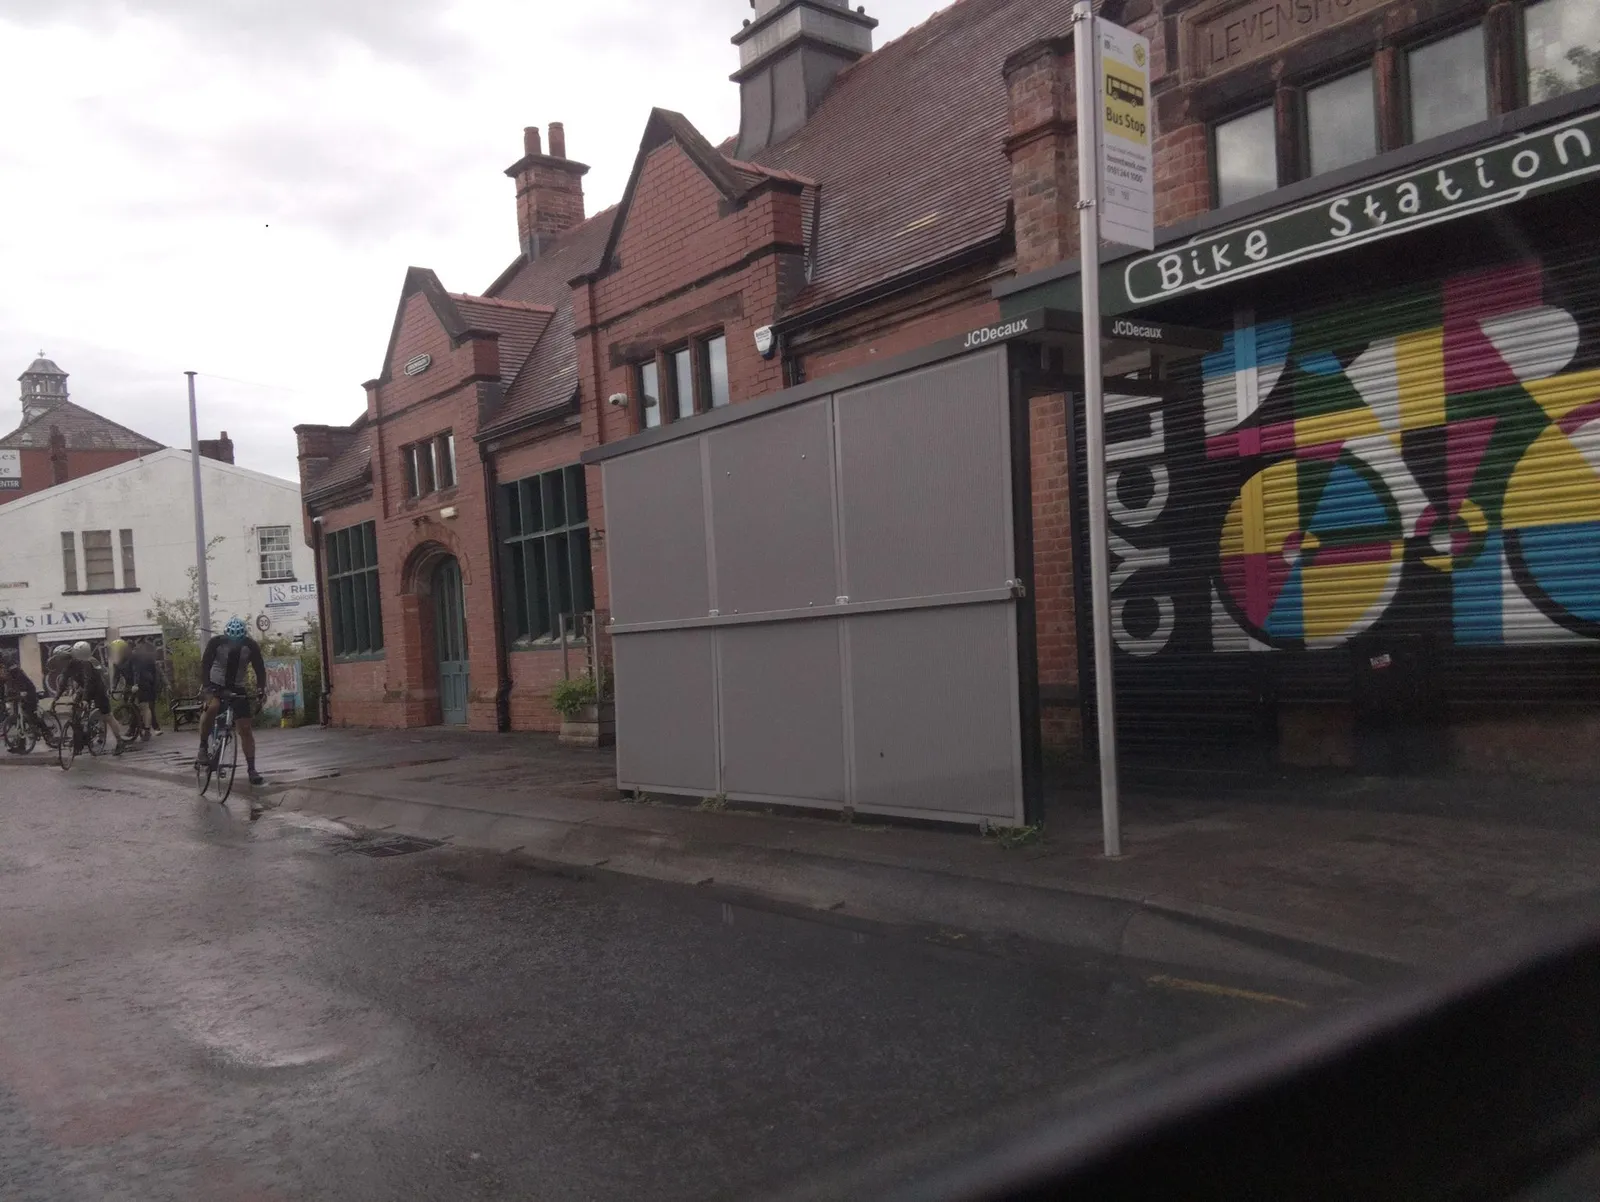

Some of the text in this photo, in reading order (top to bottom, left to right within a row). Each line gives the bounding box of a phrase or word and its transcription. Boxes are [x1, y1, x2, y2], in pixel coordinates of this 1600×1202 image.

[1208, 0, 1351, 65] LEVENSH
[1105, 106, 1146, 137] Bus Stop
[1156, 126, 1593, 292] Bike Station
[963, 317, 1030, 348] JCDecaux
[1111, 319, 1163, 340] JCDecaux
[0, 453, 17, 461] es
[46, 610, 88, 625] LAW
[259, 618, 269, 627] 30
